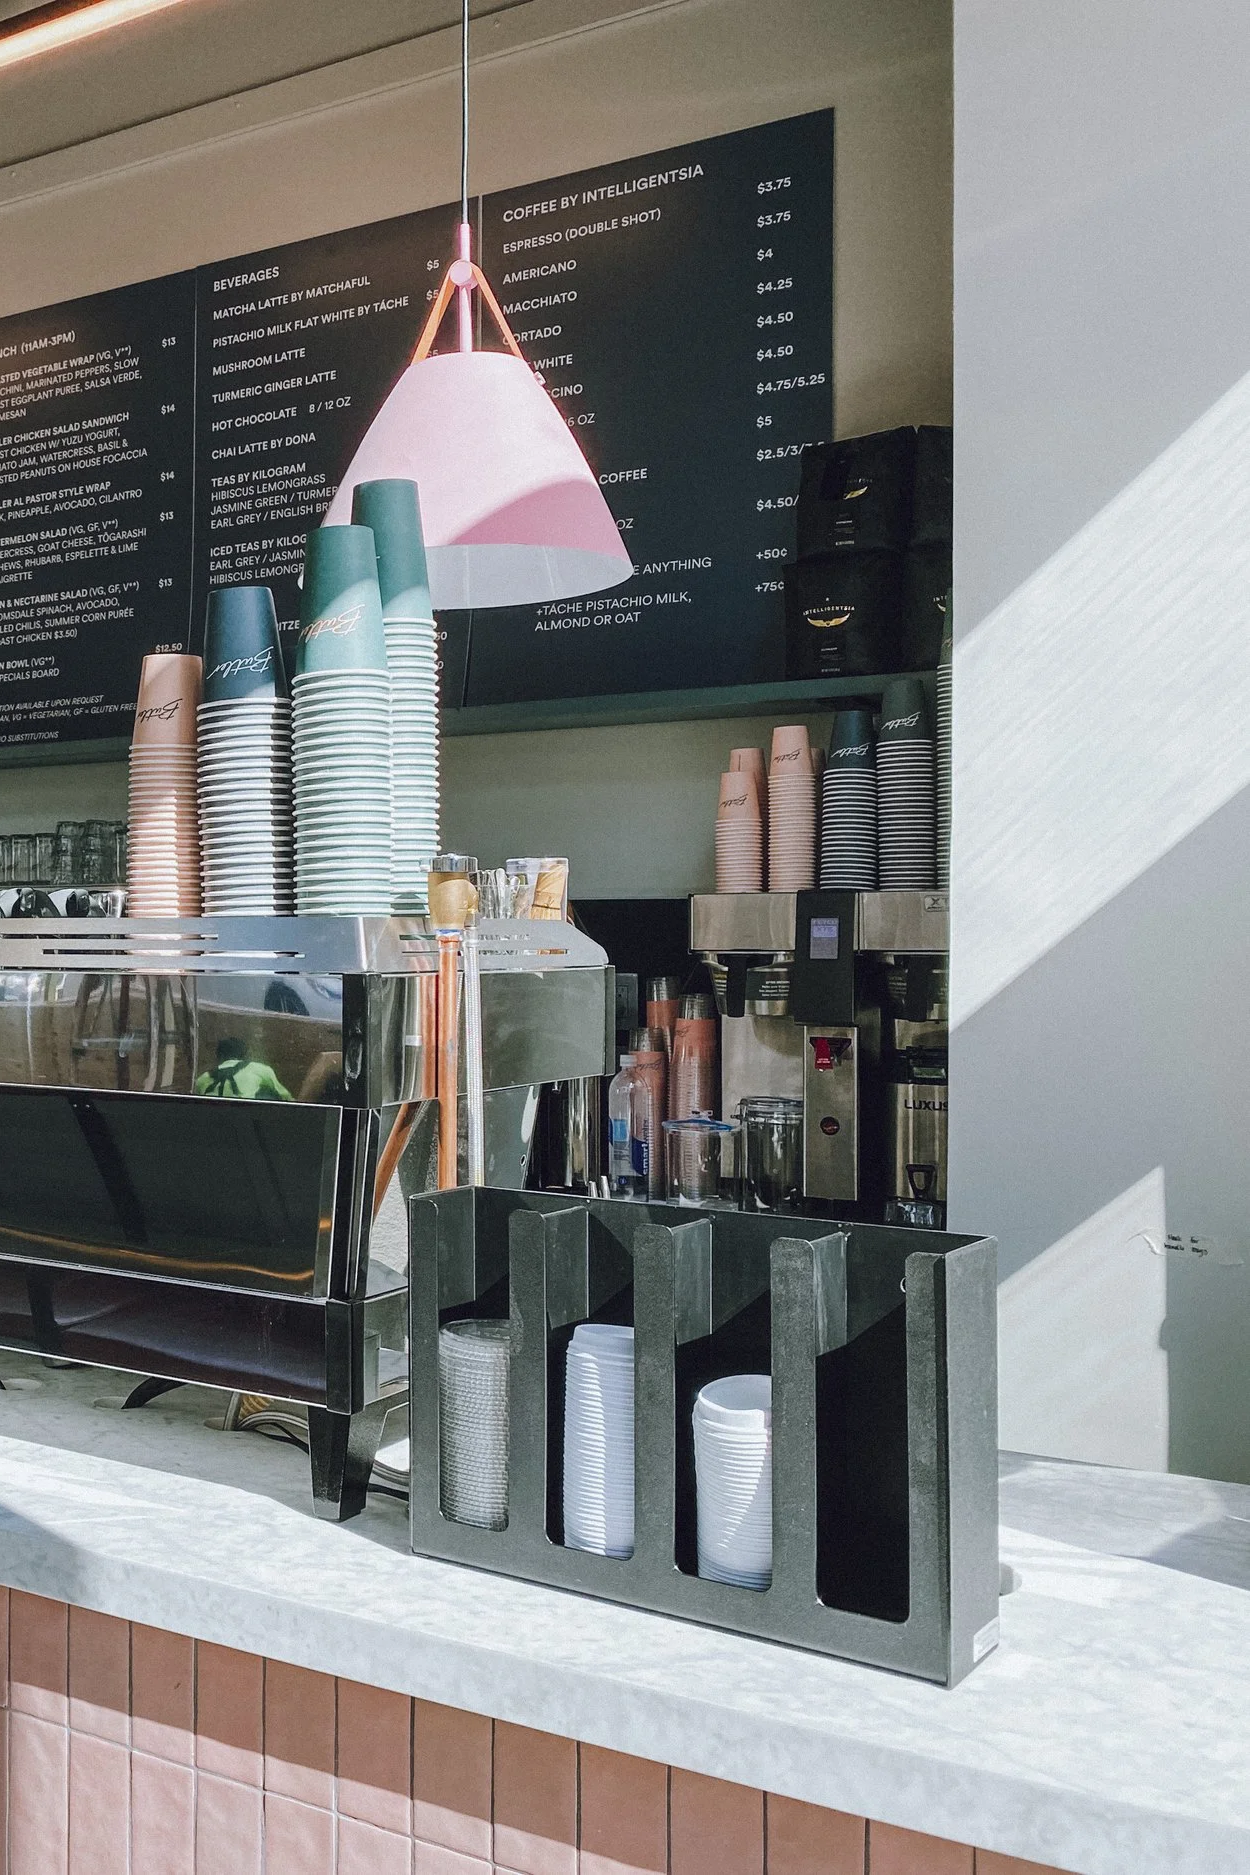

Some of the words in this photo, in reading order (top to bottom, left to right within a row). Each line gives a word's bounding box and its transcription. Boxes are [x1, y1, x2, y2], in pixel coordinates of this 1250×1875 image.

[503, 199, 556, 222] COFFEE
[560, 193, 578, 209] BY
[582, 164, 703, 204] INTELLIGENTSIA
[757, 176, 791, 194] $3.75
[756, 210, 790, 228] $3.75
[503, 231, 562, 254] ESPRESSO
[756, 248, 773, 261] $4
[426, 259, 439, 271] $5
[502, 259, 576, 285] AMERICANO
[213, 266, 279, 292] BEVERAGES
[756, 277, 792, 294] $4.25
[213, 302, 256, 320] MATCHA
[258, 294, 288, 310] LATTE
[290, 290, 303, 302] BY
[305, 275, 370, 299] MATCHAFUL
[502, 290, 577, 315] MACCHIATO
[213, 328, 264, 348] PISTACHIO
[267, 321, 292, 336] MILK
[294, 315, 319, 330] FLAT
[320, 307, 355, 324] WHITE
[357, 304, 370, 316] BY
[756, 311, 793, 328] $4.50
[161, 336, 176, 348] $13
[212, 354, 272, 376] MUSHROOM
[274, 347, 305, 363] LATTE
[533, 353, 572, 370] WHITE
[756, 344, 793, 361] $4.50
[21, 359, 67, 378] VEGETABLE
[68, 354, 94, 367] WRAP
[211, 385, 262, 403] TURMERIC
[264, 376, 302, 393] GINGER
[305, 369, 336, 385] LATTE
[756, 372, 825, 395] $4.75/5.25
[160, 403, 175, 415] $14
[211, 418, 233, 432] HOT
[234, 406, 297, 427] CHOCOLATE
[308, 403, 315, 413] 8
[316, 401, 322, 411] /
[324, 400, 333, 410] 12
[335, 396, 351, 407] OZ
[13, 427, 51, 443] CHICKEN
[52, 422, 80, 435] SALAD
[81, 411, 129, 429] SANDWICH
[577, 412, 595, 425] OZ
[756, 415, 772, 428] $5
[211, 446, 236, 459] CHAI
[238, 440, 268, 455] LATTE
[270, 437, 283, 449] BY
[285, 432, 316, 446] DONA
[160, 470, 174, 482] $14
[211, 474, 235, 487] TEAS
[237, 472, 250, 483] BY
[252, 462, 305, 480] KILOGRAM
[598, 467, 647, 484] COFFEE
[13, 497, 24, 506] AL
[25, 490, 57, 504] PASTOR
[58, 485, 84, 498] STYLE
[85, 480, 111, 493] WRAP
[98, 488, 142, 504] CILANTRO
[211, 485, 254, 501] HIBISCUS
[256, 473, 325, 494] LEMONGRASS
[210, 499, 252, 515] JASMINE
[254, 493, 287, 508] GREEN
[159, 510, 173, 522] $13
[210, 517, 234, 529] EARL
[235, 512, 261, 525] GREY
[270, 504, 313, 519] ENGLISH
[617, 517, 633, 530] OZ
[210, 545, 232, 557] ICED
[234, 540, 259, 553] TEAS
[261, 538, 274, 549] BY
[755, 547, 787, 559] +50¢
[209, 559, 233, 571] EARL
[235, 554, 260, 567] GREY
[642, 556, 711, 574] ANYTHING
[158, 577, 172, 588] $13
[209, 569, 252, 584] HIBISCUS
[754, 581, 784, 592] +75¢
[586, 594, 652, 611] PISTACHIO
[534, 616, 590, 631] ALMOND
[593, 614, 611, 625] OR
[614, 611, 641, 623] OAT
[155, 642, 182, 653] $12.50
[206, 646, 274, 680] Butler
[31, 667, 59, 678] BOARD
